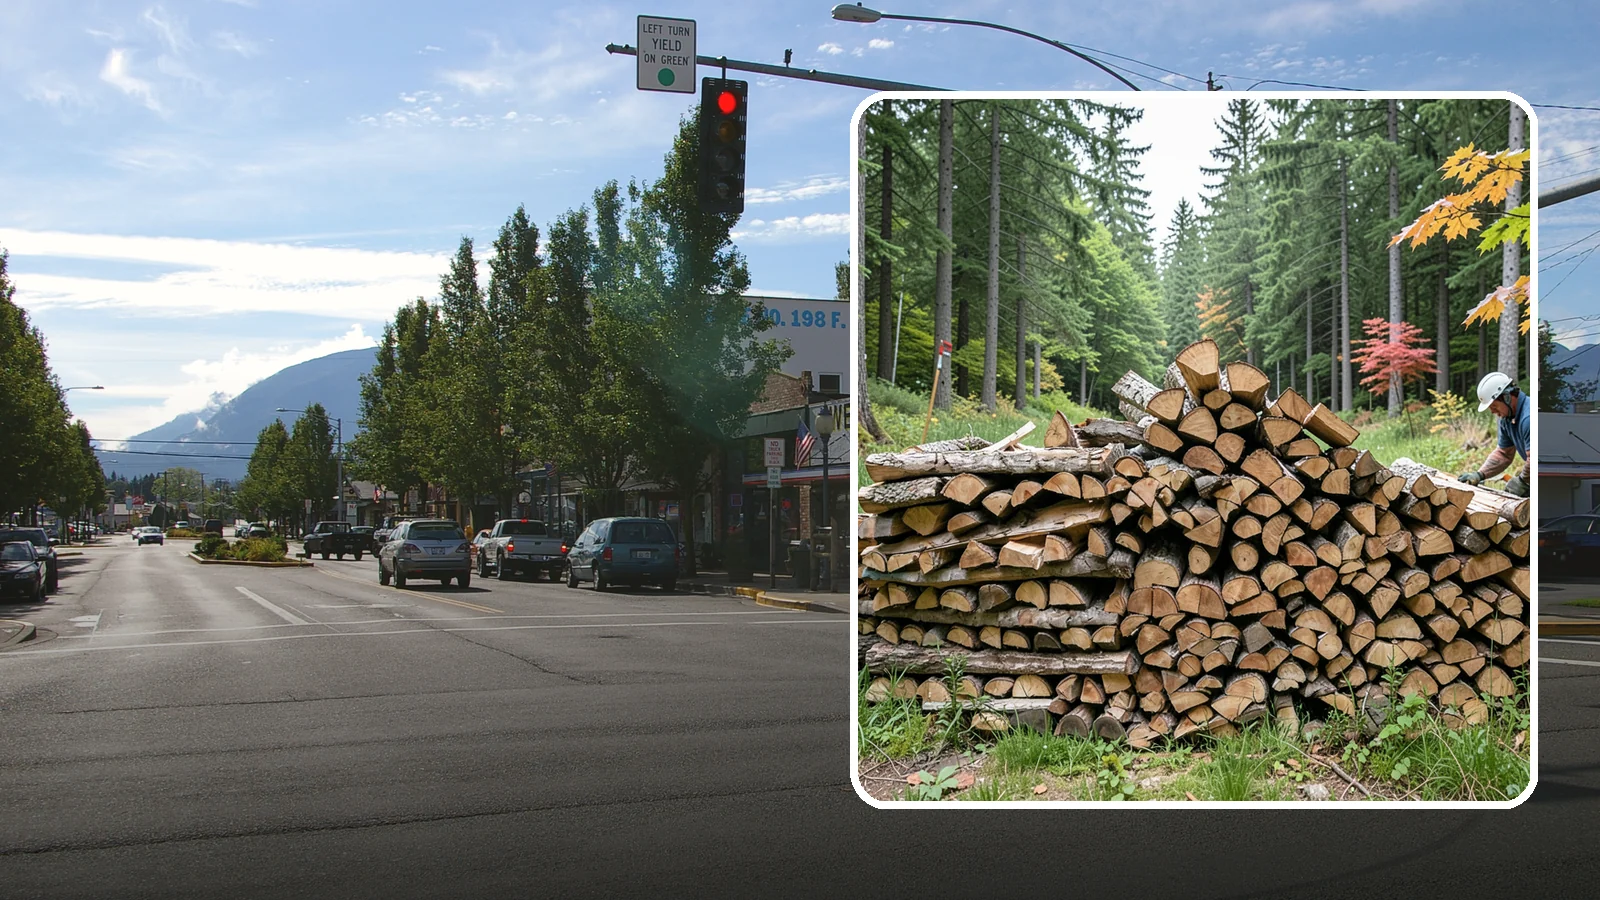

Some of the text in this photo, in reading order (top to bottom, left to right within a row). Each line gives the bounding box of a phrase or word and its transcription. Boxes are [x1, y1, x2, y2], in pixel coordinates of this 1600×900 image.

[643, 24, 690, 36] LEFT TURN
[652, 38, 682, 52] YIELD
[644, 53, 689, 66] ON GREEN
[791, 309, 826, 328] 198
[831, 311, 846, 328] F.
